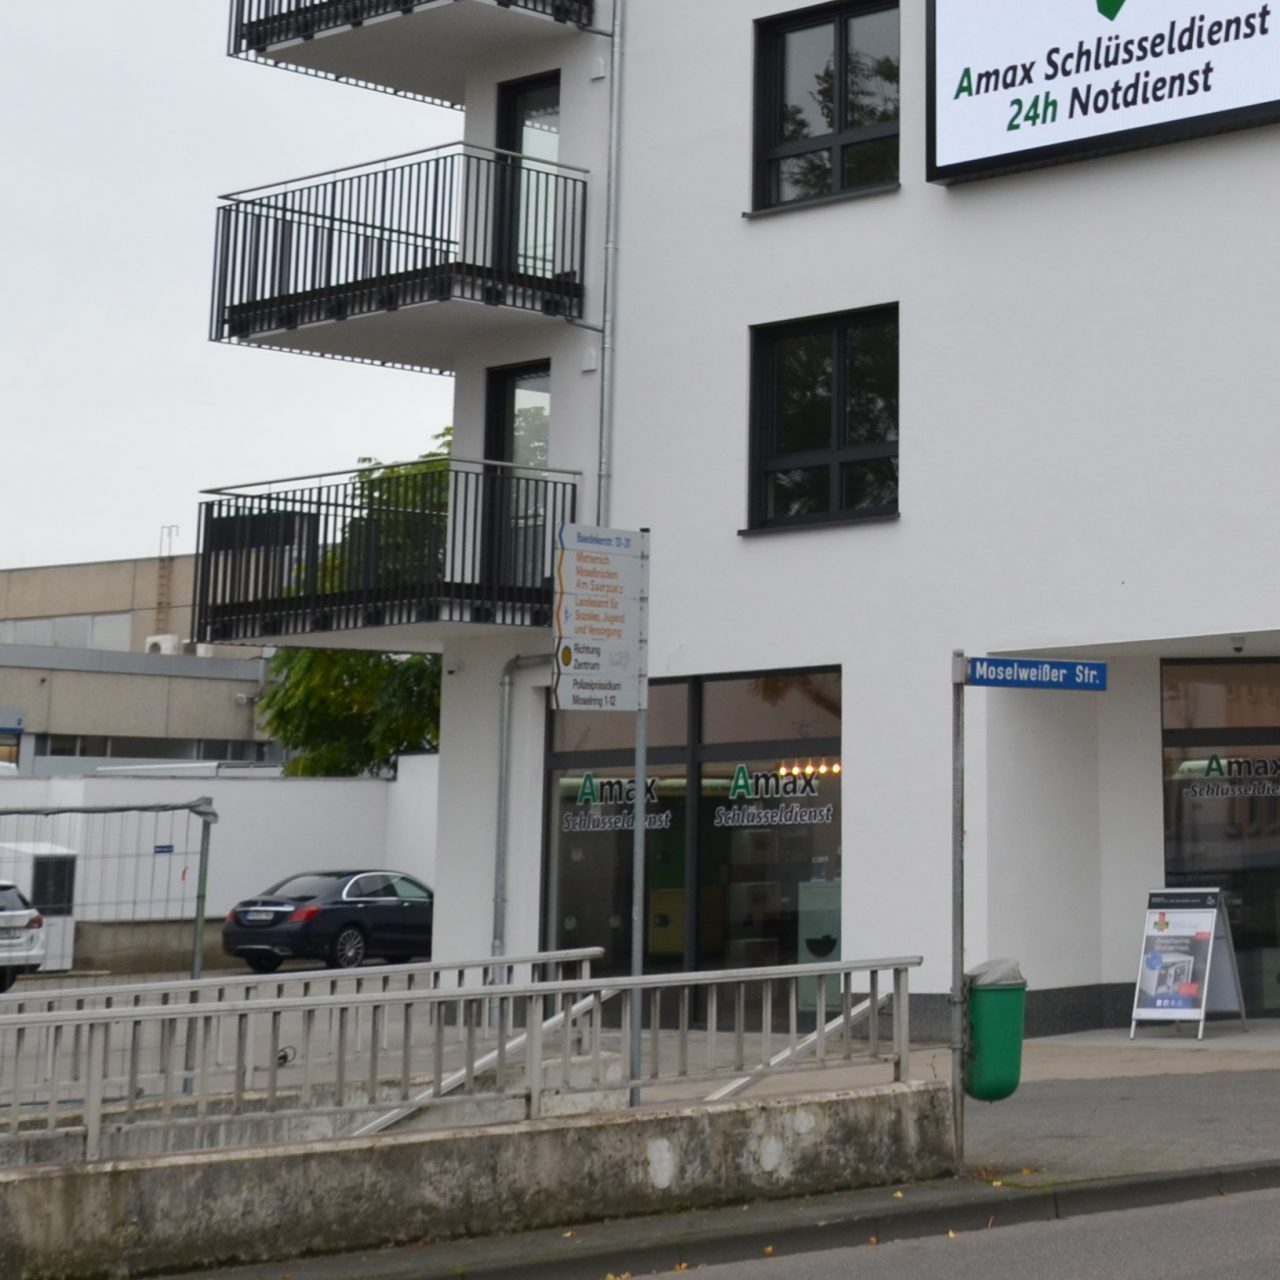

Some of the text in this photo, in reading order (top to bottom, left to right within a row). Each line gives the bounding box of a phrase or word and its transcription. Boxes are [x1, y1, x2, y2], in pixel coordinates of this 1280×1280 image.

[953, 3, 1271, 100] Amax Schlüsseldienst
[1006, 60, 1214, 132] 24h Notdienst
[573, 658, 600, 670] Zentrum
[574, 642, 601, 658] Richtung
[975, 661, 1100, 684] Moselweißer Str.
[576, 772, 659, 805] Amax
[729, 764, 818, 799] Amax
[713, 803, 833, 826] Schlüsseldienst
